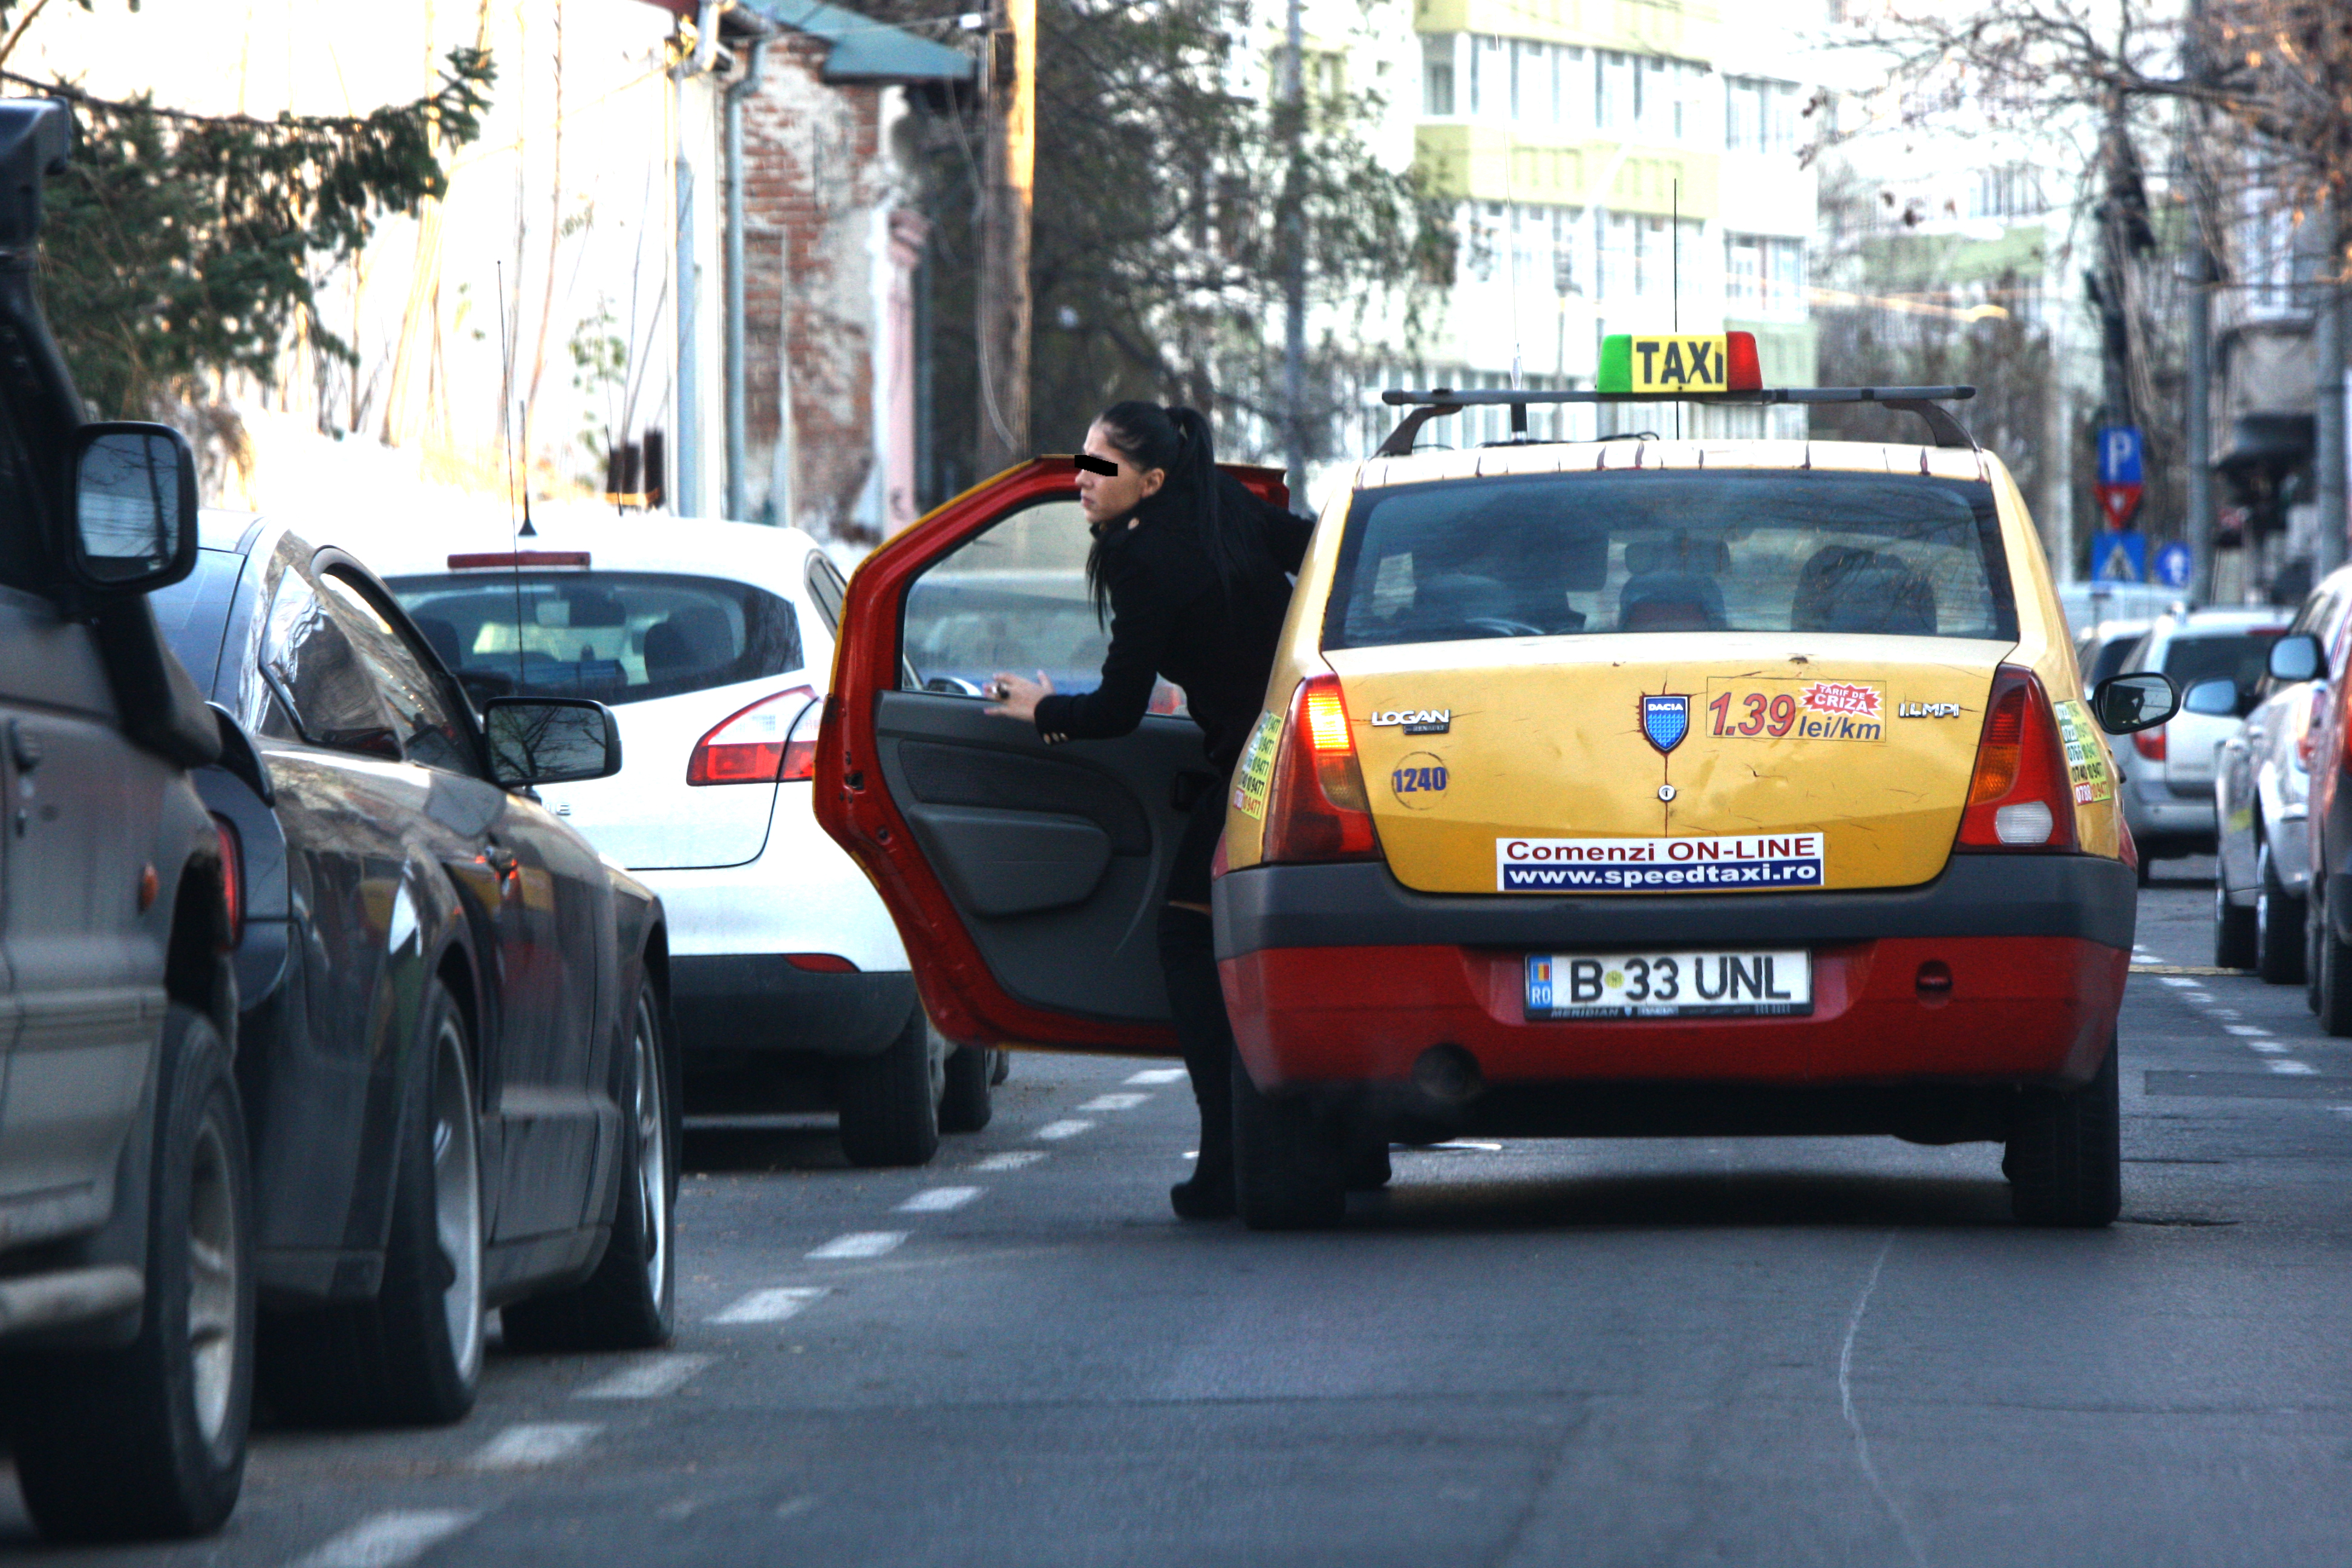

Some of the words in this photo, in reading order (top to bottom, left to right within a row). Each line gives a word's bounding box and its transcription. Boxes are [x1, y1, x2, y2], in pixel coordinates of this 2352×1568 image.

[2109, 430, 2132, 482] P
[1814, 694, 1869, 713] CRIZA
[1820, 685, 1849, 697] TARIF
[1851, 690, 1866, 701] DE
[1371, 709, 1449, 726] LOGAN
[1709, 691, 1796, 737] 1.39
[1798, 716, 1881, 740] lei/km
[1393, 766, 1446, 792] 1240
[1507, 841, 1655, 861] Comenzi
[1668, 837, 1815, 861] ON-LINE
[1509, 863, 1817, 888] www.speedtaxi.ro
[1571, 959, 1603, 1002] B
[1624, 957, 1679, 1001] 33
[1695, 956, 1791, 1000] UNL
[1532, 985, 1551, 1004] RO
[1550, 1007, 1619, 1019] MERIDIAN
